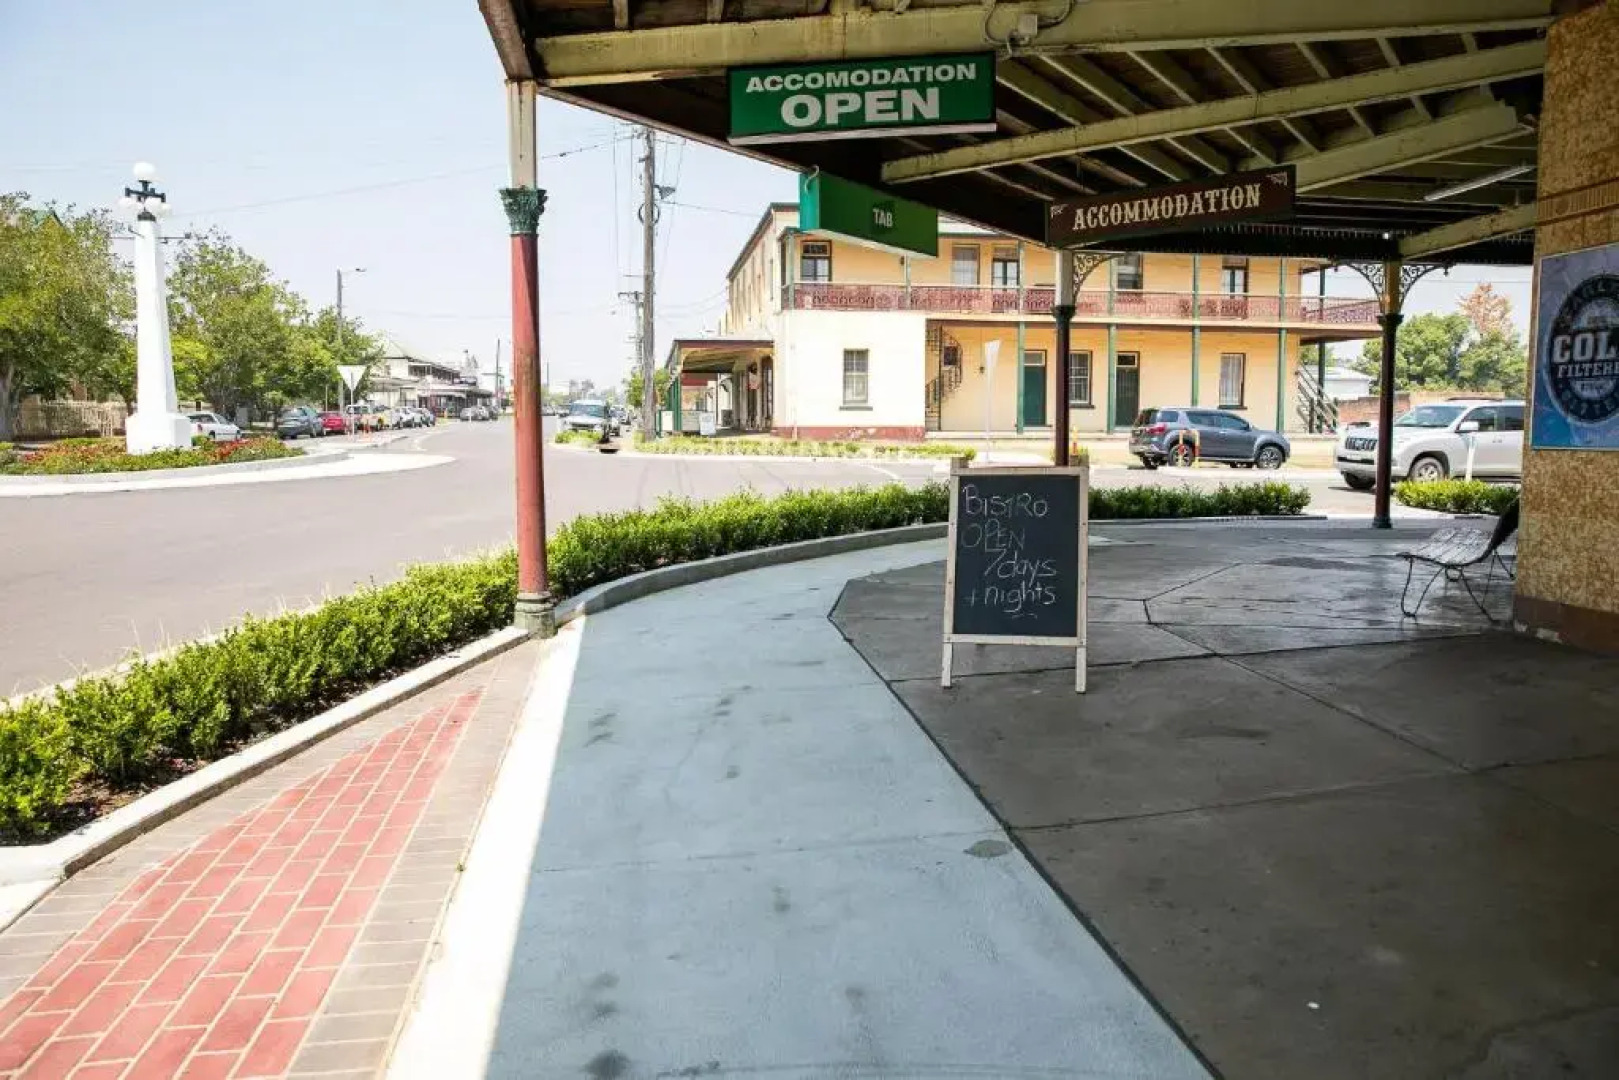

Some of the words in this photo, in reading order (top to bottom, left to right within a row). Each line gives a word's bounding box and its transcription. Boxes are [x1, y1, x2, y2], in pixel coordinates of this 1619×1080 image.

[746, 63, 976, 93] ACCOMODATION
[780, 87, 940, 127] OPEN
[873, 208, 894, 229] TAB
[1072, 183, 1261, 231] ACCOMMODATION
[961, 518, 1026, 551] OPEN
[984, 580, 1057, 614] nights
